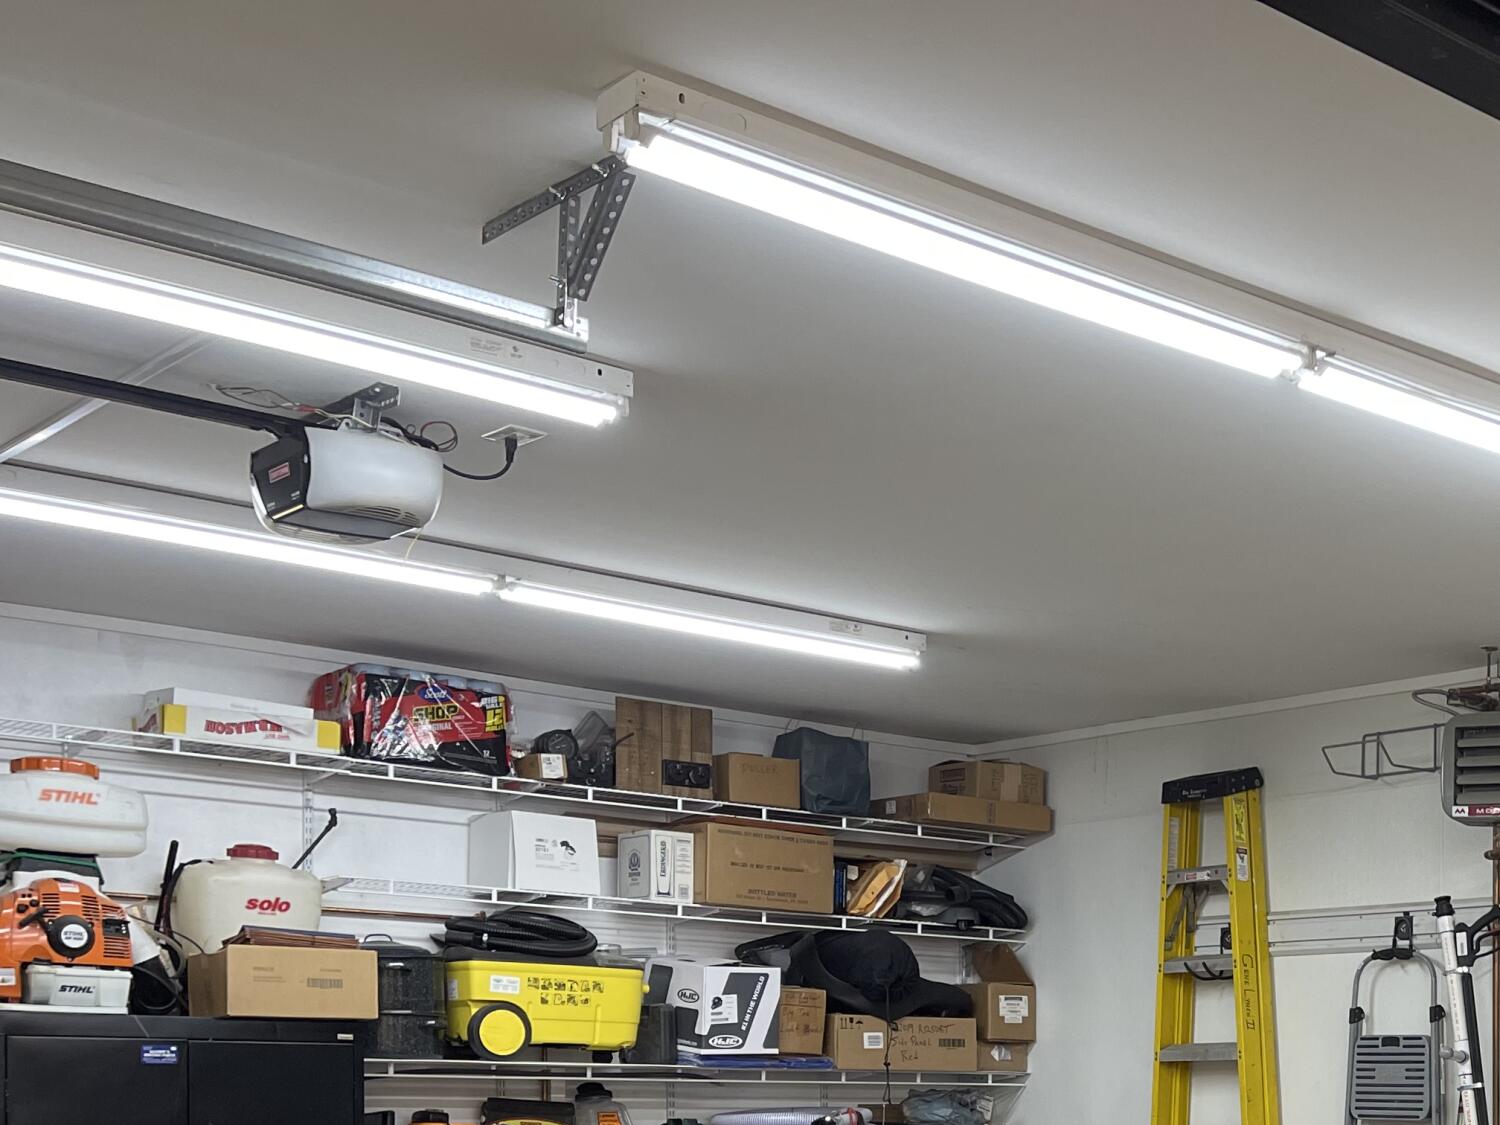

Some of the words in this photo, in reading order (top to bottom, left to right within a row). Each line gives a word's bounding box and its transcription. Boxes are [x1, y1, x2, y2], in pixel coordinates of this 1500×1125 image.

[424, 687, 447, 700] Scott
[412, 704, 460, 721] SHOP
[39, 788, 99, 805] STIHL
[245, 897, 291, 913] solo
[59, 984, 94, 994] STIHL
[679, 990, 698, 1000] HJC
[753, 976, 765, 1000] WORLD
[711, 1035, 740, 1046] HJC
